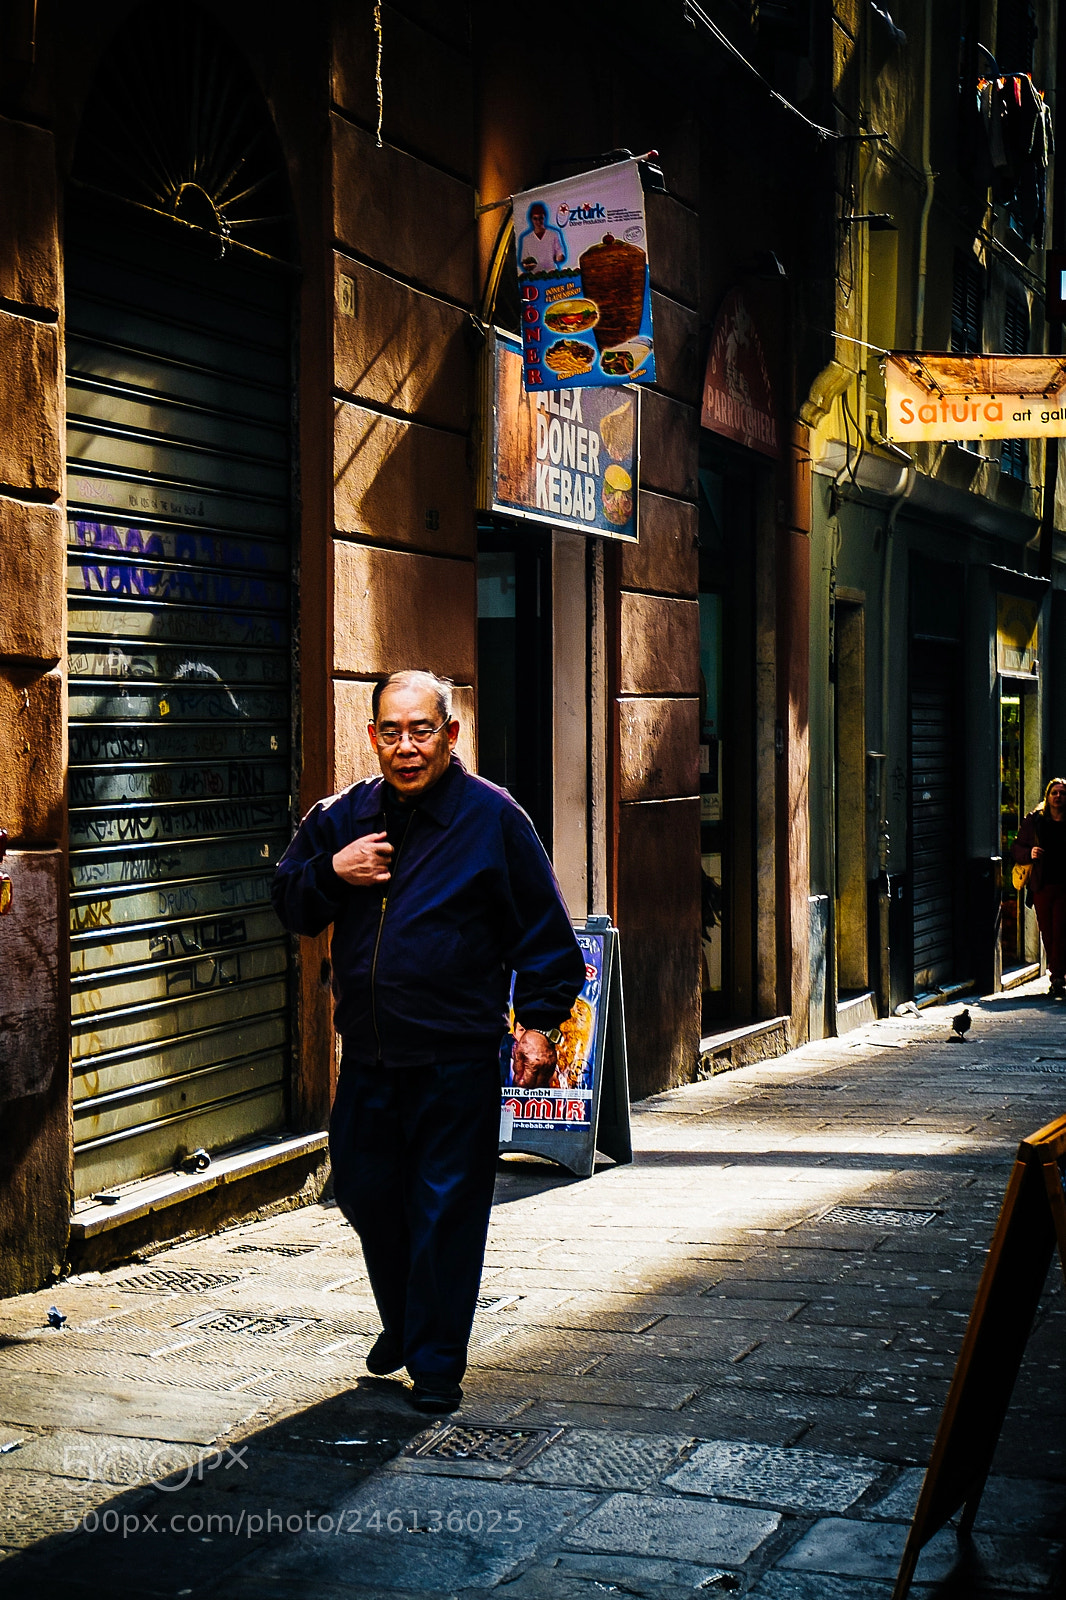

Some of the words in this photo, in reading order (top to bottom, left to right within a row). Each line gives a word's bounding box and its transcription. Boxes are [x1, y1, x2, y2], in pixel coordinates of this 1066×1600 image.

[899, 398, 1003, 424] Satura
[1012, 410, 1032, 422] art
[536, 413, 600, 476] DONER
[536, 463, 596, 521] KEBAB
[158, 887, 198, 914] DRUMS
[501, 1089, 521, 1097] MIR
[523, 1089, 551, 1097] GmbH
[504, 1097, 586, 1121] AMIR
